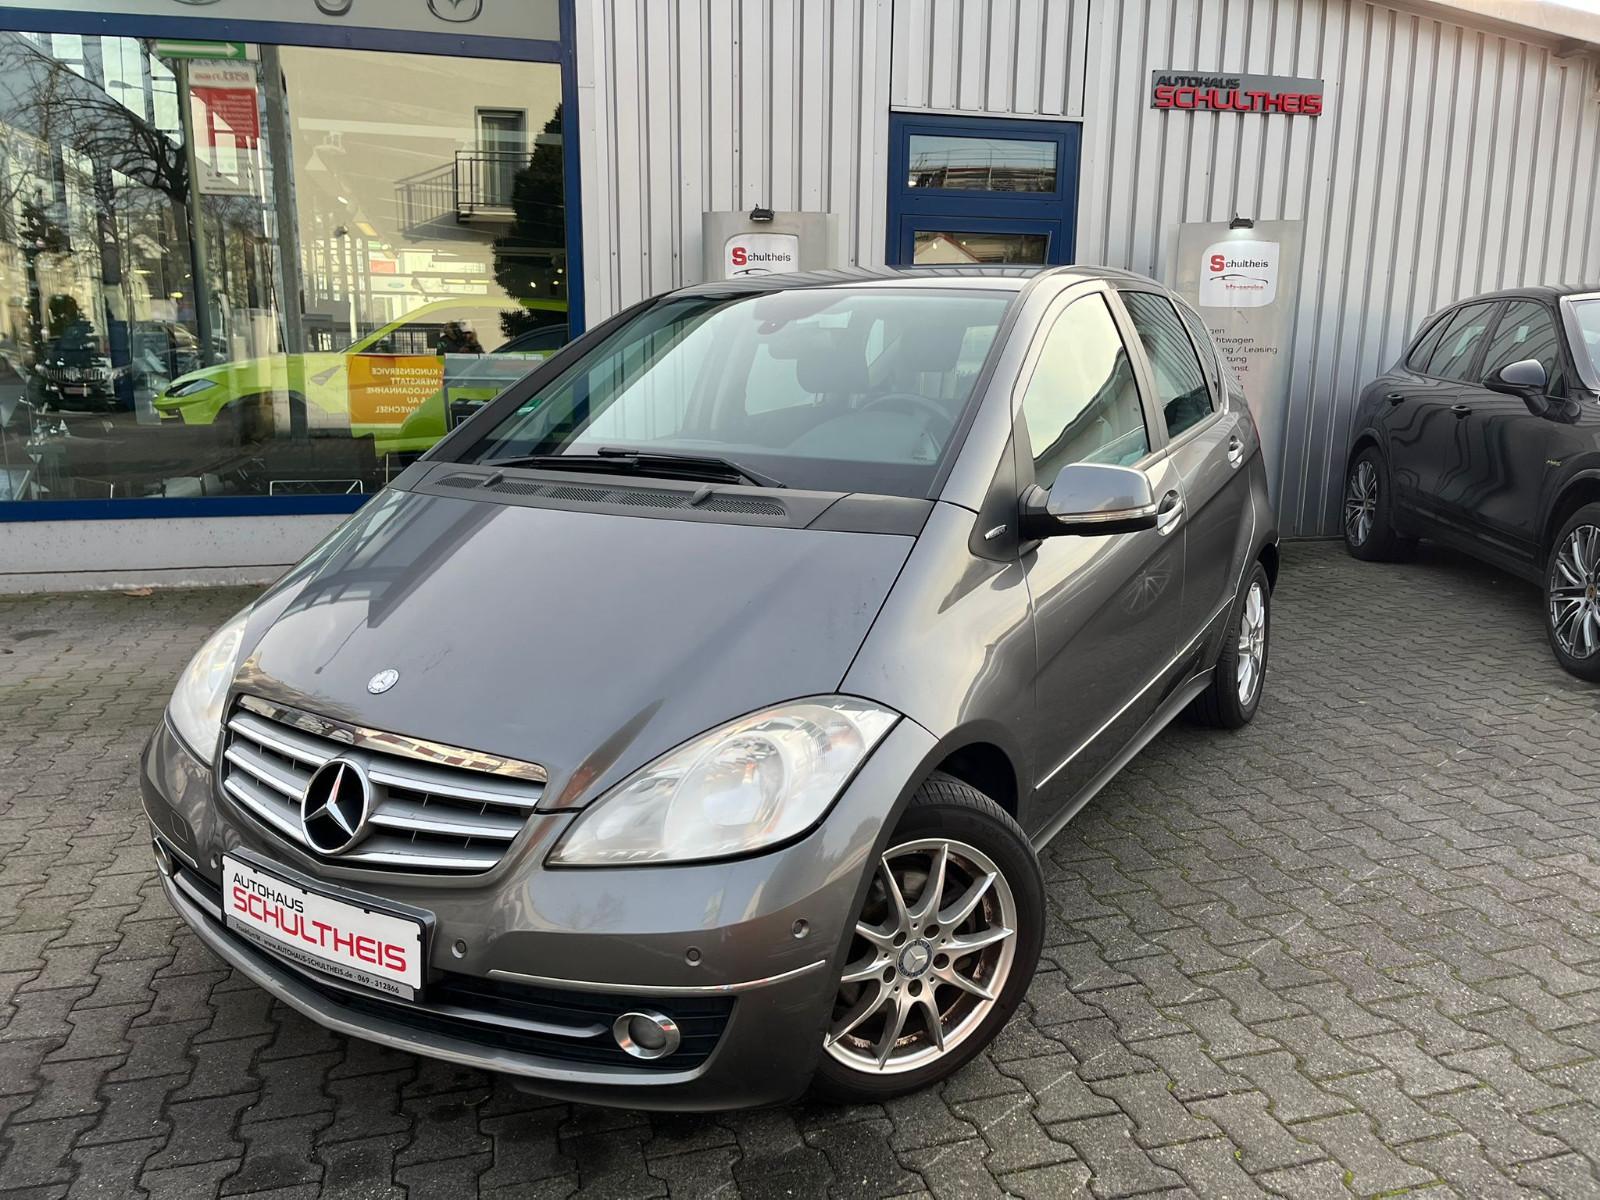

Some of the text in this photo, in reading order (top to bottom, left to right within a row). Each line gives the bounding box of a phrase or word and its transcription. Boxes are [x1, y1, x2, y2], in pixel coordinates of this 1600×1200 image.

[1156, 75, 1240, 89] AUTOHAUS
[1154, 86, 1323, 114] SCHULTHEIS
[732, 246, 791, 266] Schultheis
[1210, 254, 1269, 272] Schultheis
[1244, 346, 1278, 355] Leasing
[233, 872, 304, 914] AUTOHAUS
[233, 886, 407, 972] SCHULTHEIS
[357, 974, 370, 985] 069
[374, 980, 400, 994] 312866
